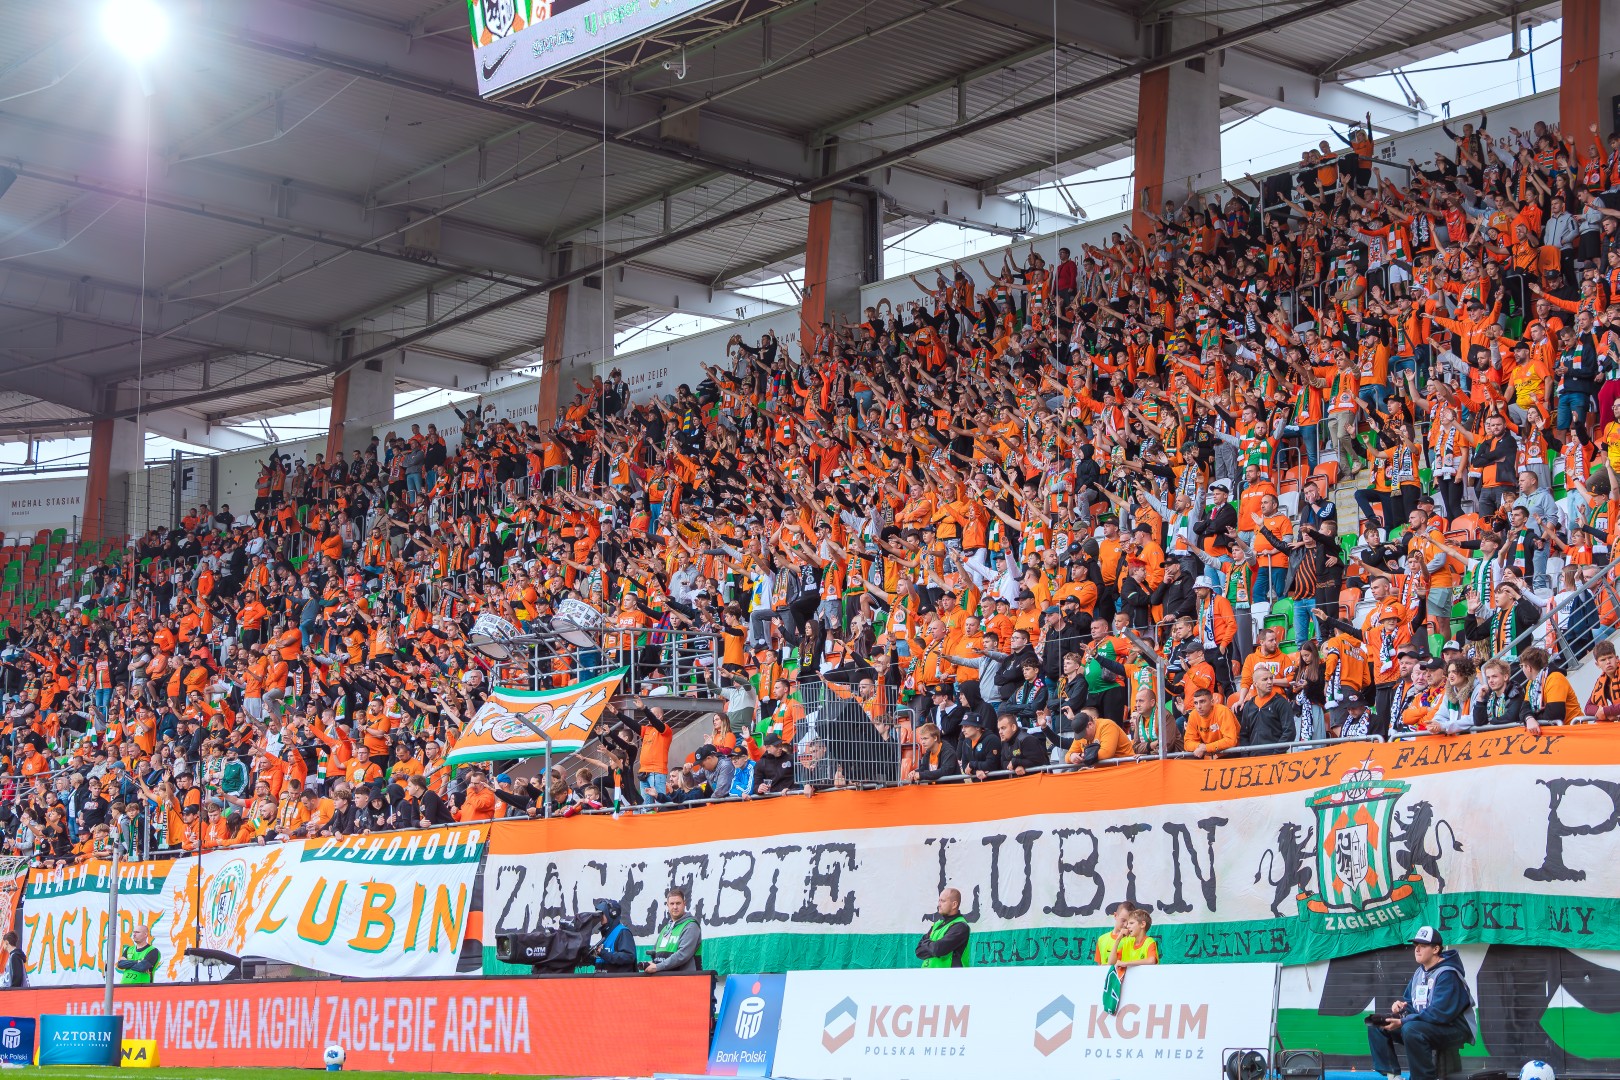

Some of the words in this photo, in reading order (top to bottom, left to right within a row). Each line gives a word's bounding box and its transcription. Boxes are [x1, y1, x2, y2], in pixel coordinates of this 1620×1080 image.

[648, 367, 668, 381] ZEIER
[182, 467, 194, 490] F
[46, 496, 80, 507] STASIAK
[1201, 752, 1341, 791] LUBIŃSCY
[1392, 734, 1565, 769] FANATYCY
[314, 829, 481, 861] DISHONOUR
[33, 864, 89, 895] DEATH
[922, 816, 1229, 923] LUBIN
[254, 876, 467, 954] LUBIN
[1324, 904, 1405, 931] ZAGŁĘBIE
[1184, 928, 1290, 958] ZGINIE
[1439, 900, 1523, 932] PÓKI
[1547, 906, 1594, 935] MY
[164, 999, 220, 1049] MECZ
[223, 998, 251, 1049] NA
[257, 997, 320, 1049] KGHM
[324, 996, 437, 1064] ZAGŁĘBIE
[442, 996, 531, 1053] ARENA
[867, 1004, 971, 1038] KGHM
[1087, 1003, 1209, 1040] KGHM
[53, 1031, 112, 1042] AZTORIN
[865, 1046, 915, 1056] POLSKA
[924, 1044, 966, 1056] MIEDŹ
[9, 1053, 28, 1061] Polski
[121, 1047, 147, 1060] NA
[716, 1051, 739, 1063] Bank
[739, 1051, 767, 1063] Polski
[1084, 1048, 1144, 1059] POLSKA
[1154, 1046, 1205, 1059] MIEDŹ
